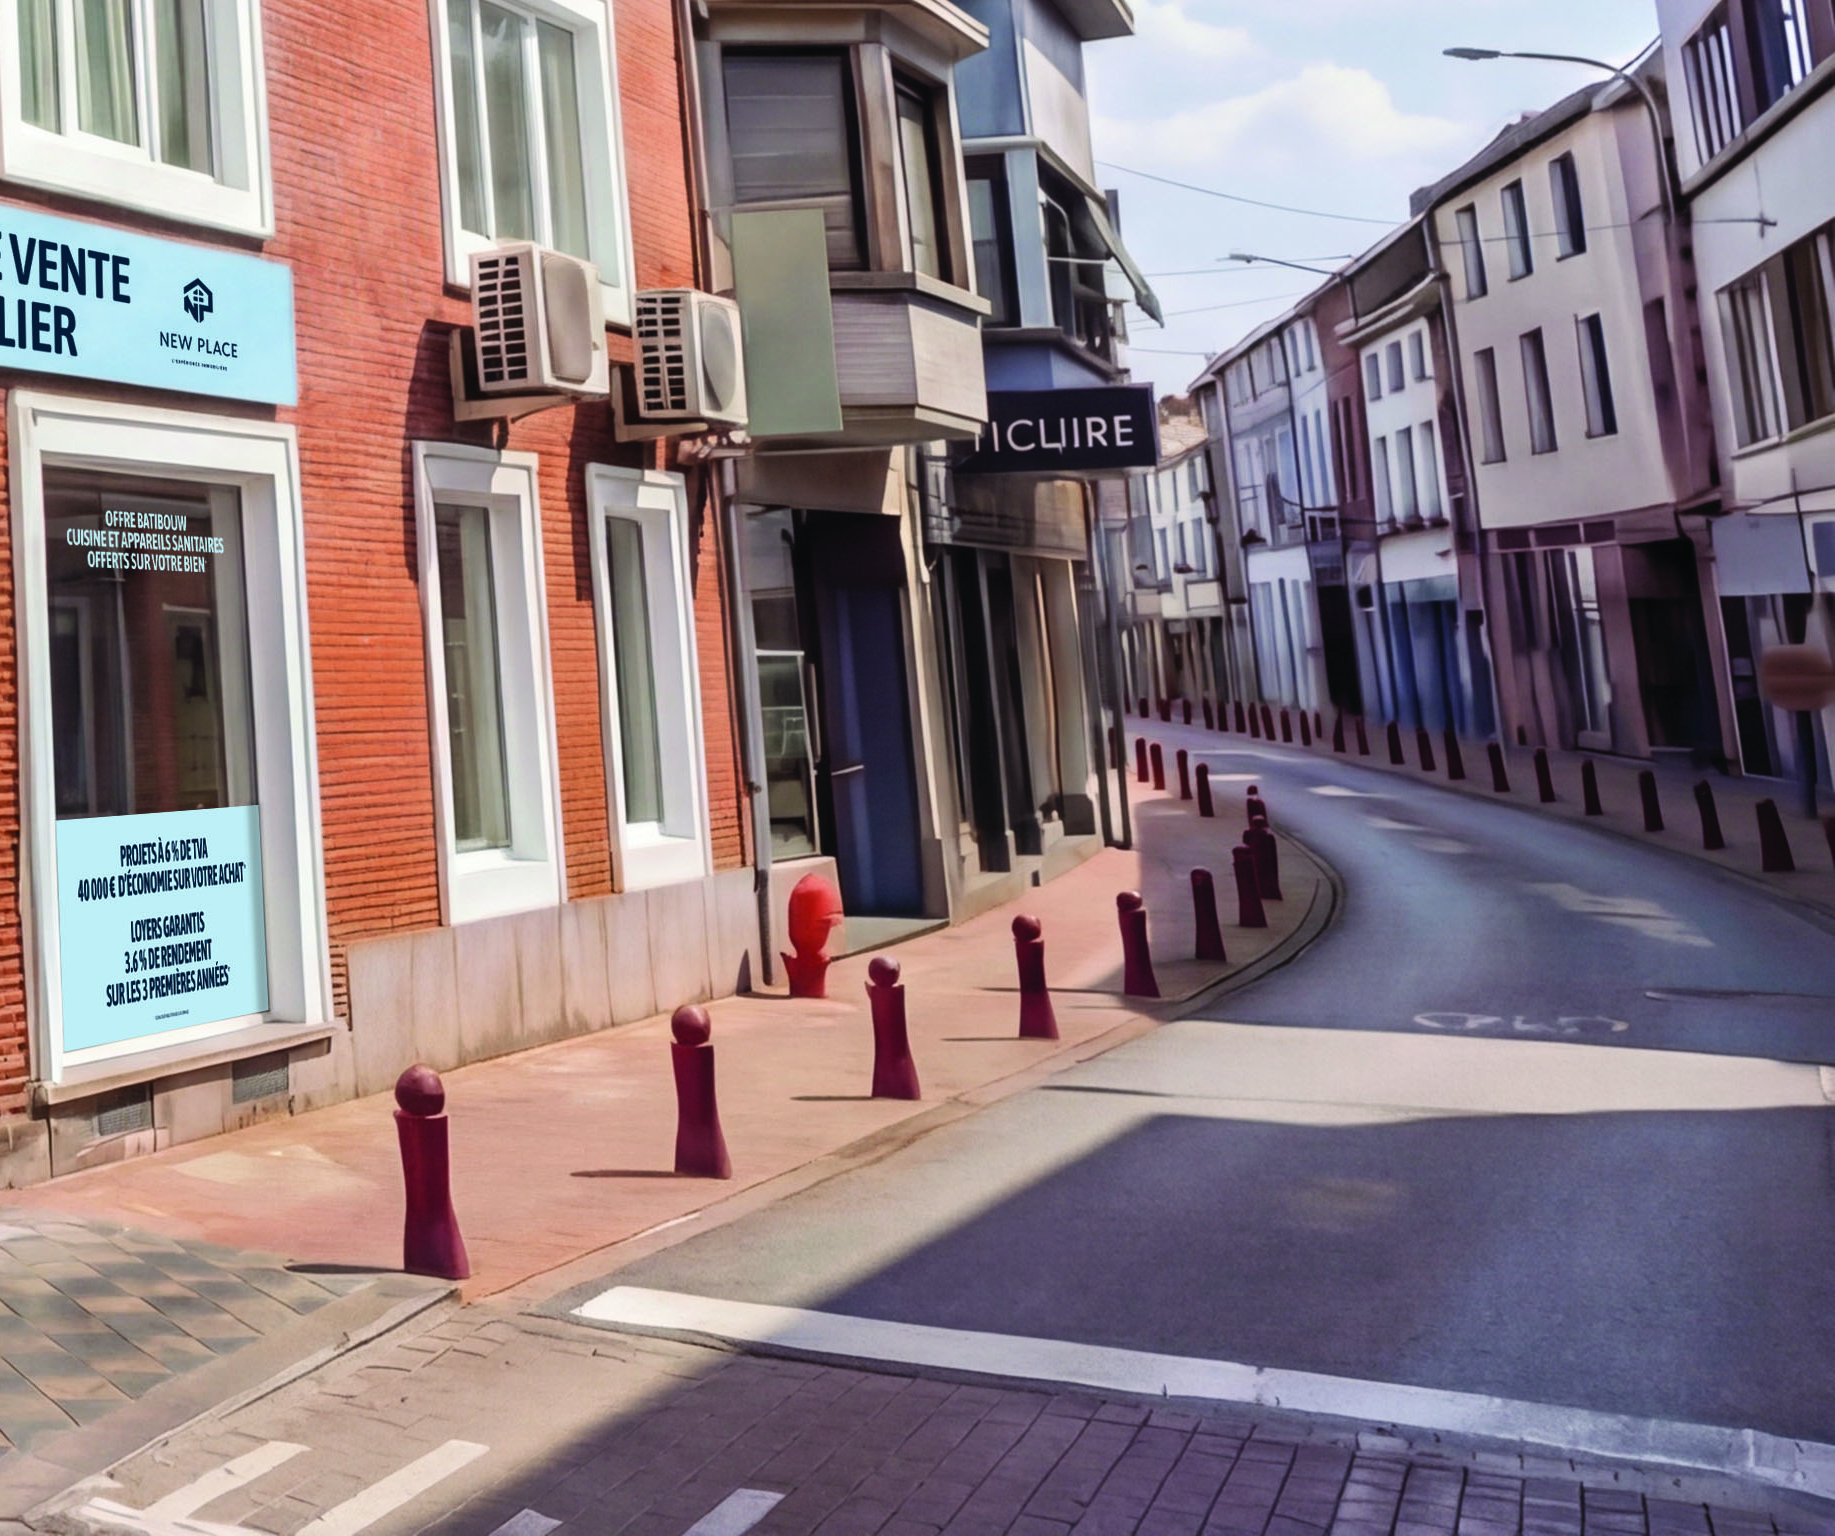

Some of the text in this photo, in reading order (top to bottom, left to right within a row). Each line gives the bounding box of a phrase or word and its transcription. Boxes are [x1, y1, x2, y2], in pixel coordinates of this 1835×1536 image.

[8, 233, 131, 304] VENTE
[159, 331, 238, 359] NEW PLACE
[105, 510, 187, 531] OFFRE BATIBOUW
[66, 528, 224, 553] CUISINE ET APPAREILS SANITAIRES
[87, 551, 129, 570] OFFERTS
[131, 553, 150, 570] SUR
[152, 553, 182, 572] VOTRE
[120, 837, 208, 867] PROJETS À 6 % DE TVA
[77, 878, 90, 902] 40
[91, 876, 108, 901] 000
[109, 876, 116, 898] €
[118, 869, 173, 898] D'ÉCONOMIE
[174, 868, 191, 890] SUR
[192, 864, 218, 888] VOTRE
[131, 911, 205, 943] LOYERS GARANTIS
[124, 939, 212, 974] 3.6 % DE RENDEMENT
[106, 982, 126, 1007] SUR
[126, 979, 141, 1003] LES
[142, 978, 148, 1001] 3
[149, 968, 196, 999] PREMIÈRES
